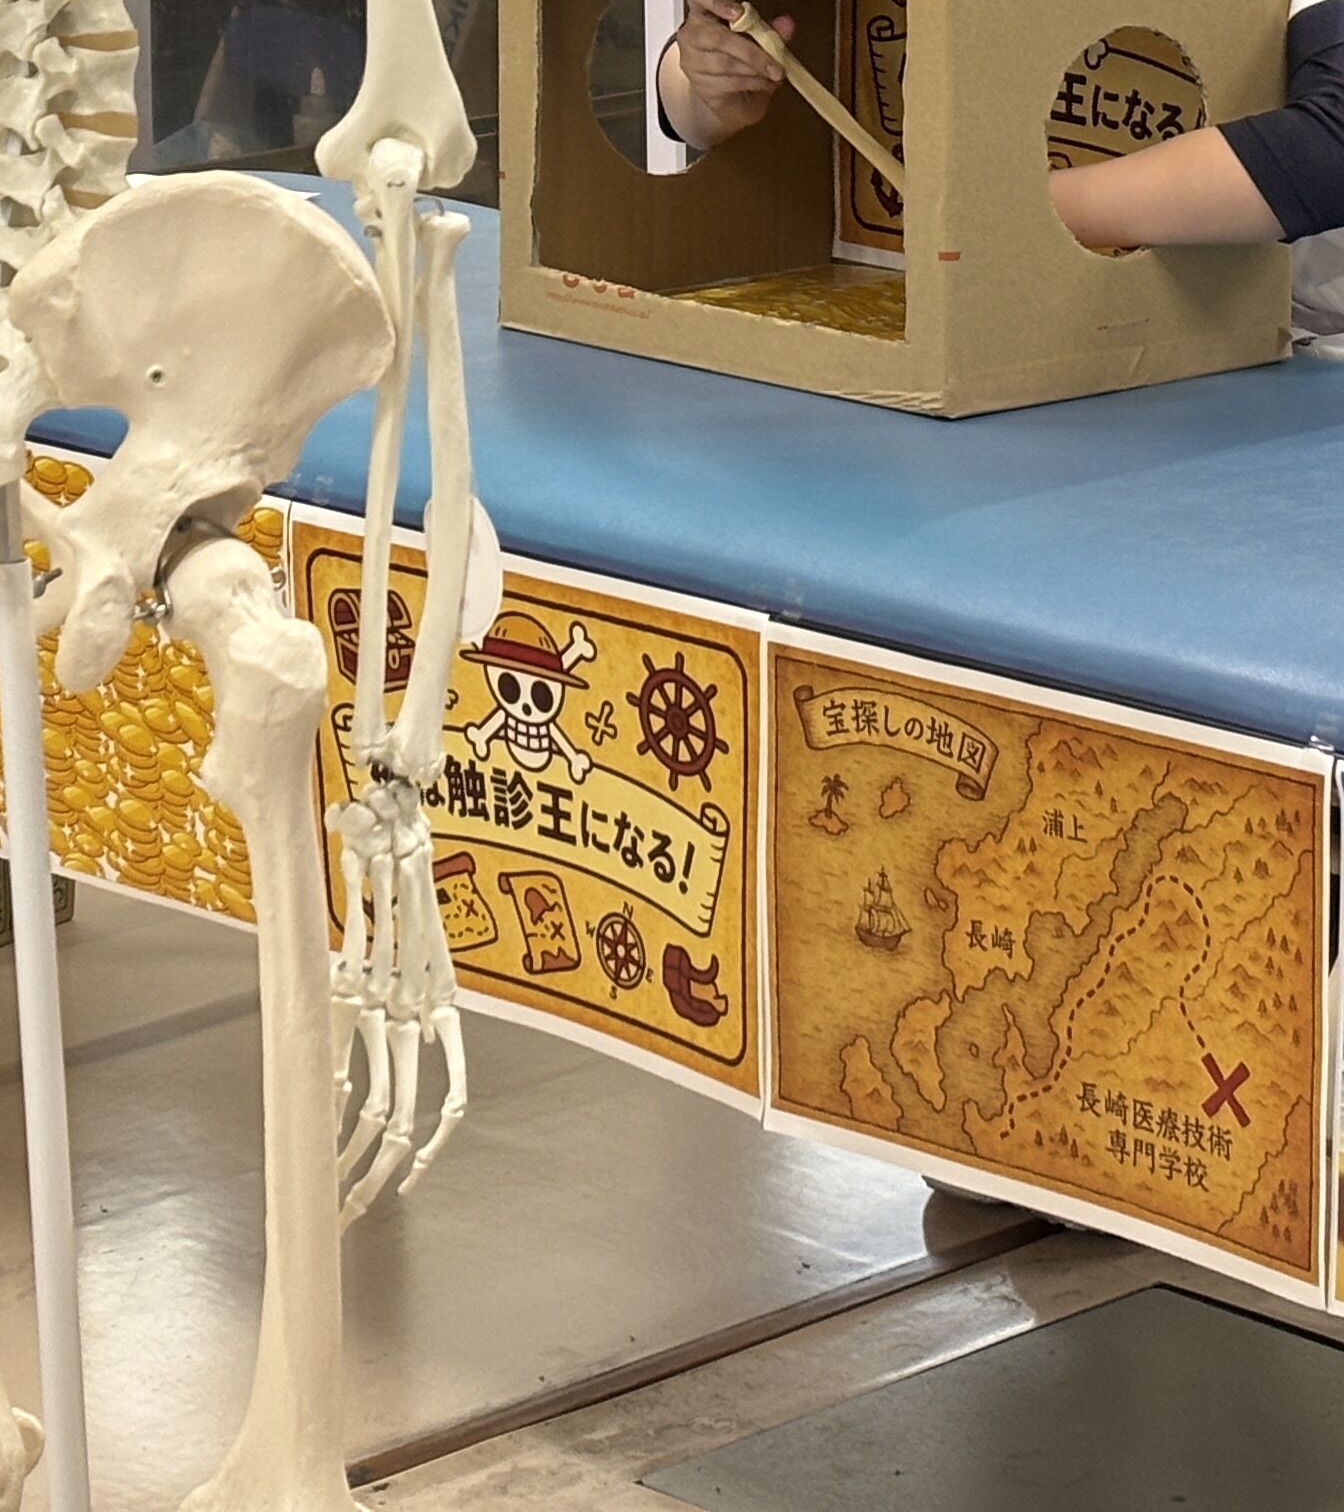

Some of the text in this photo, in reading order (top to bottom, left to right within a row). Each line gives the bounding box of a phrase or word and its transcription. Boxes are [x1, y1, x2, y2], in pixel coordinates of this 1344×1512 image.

[822, 699, 986, 774] 宝探しの地図
[1042, 808, 1089, 845] 浦上
[623, 901, 634, 918] N
[585, 921, 596, 939] W
[965, 918, 1016, 960] 長崎
[609, 984, 618, 1000] S
[645, 966, 654, 983] E
[1076, 1082, 1234, 1161] 長崎医療技術
[1106, 1129, 1210, 1191] 専門学校
